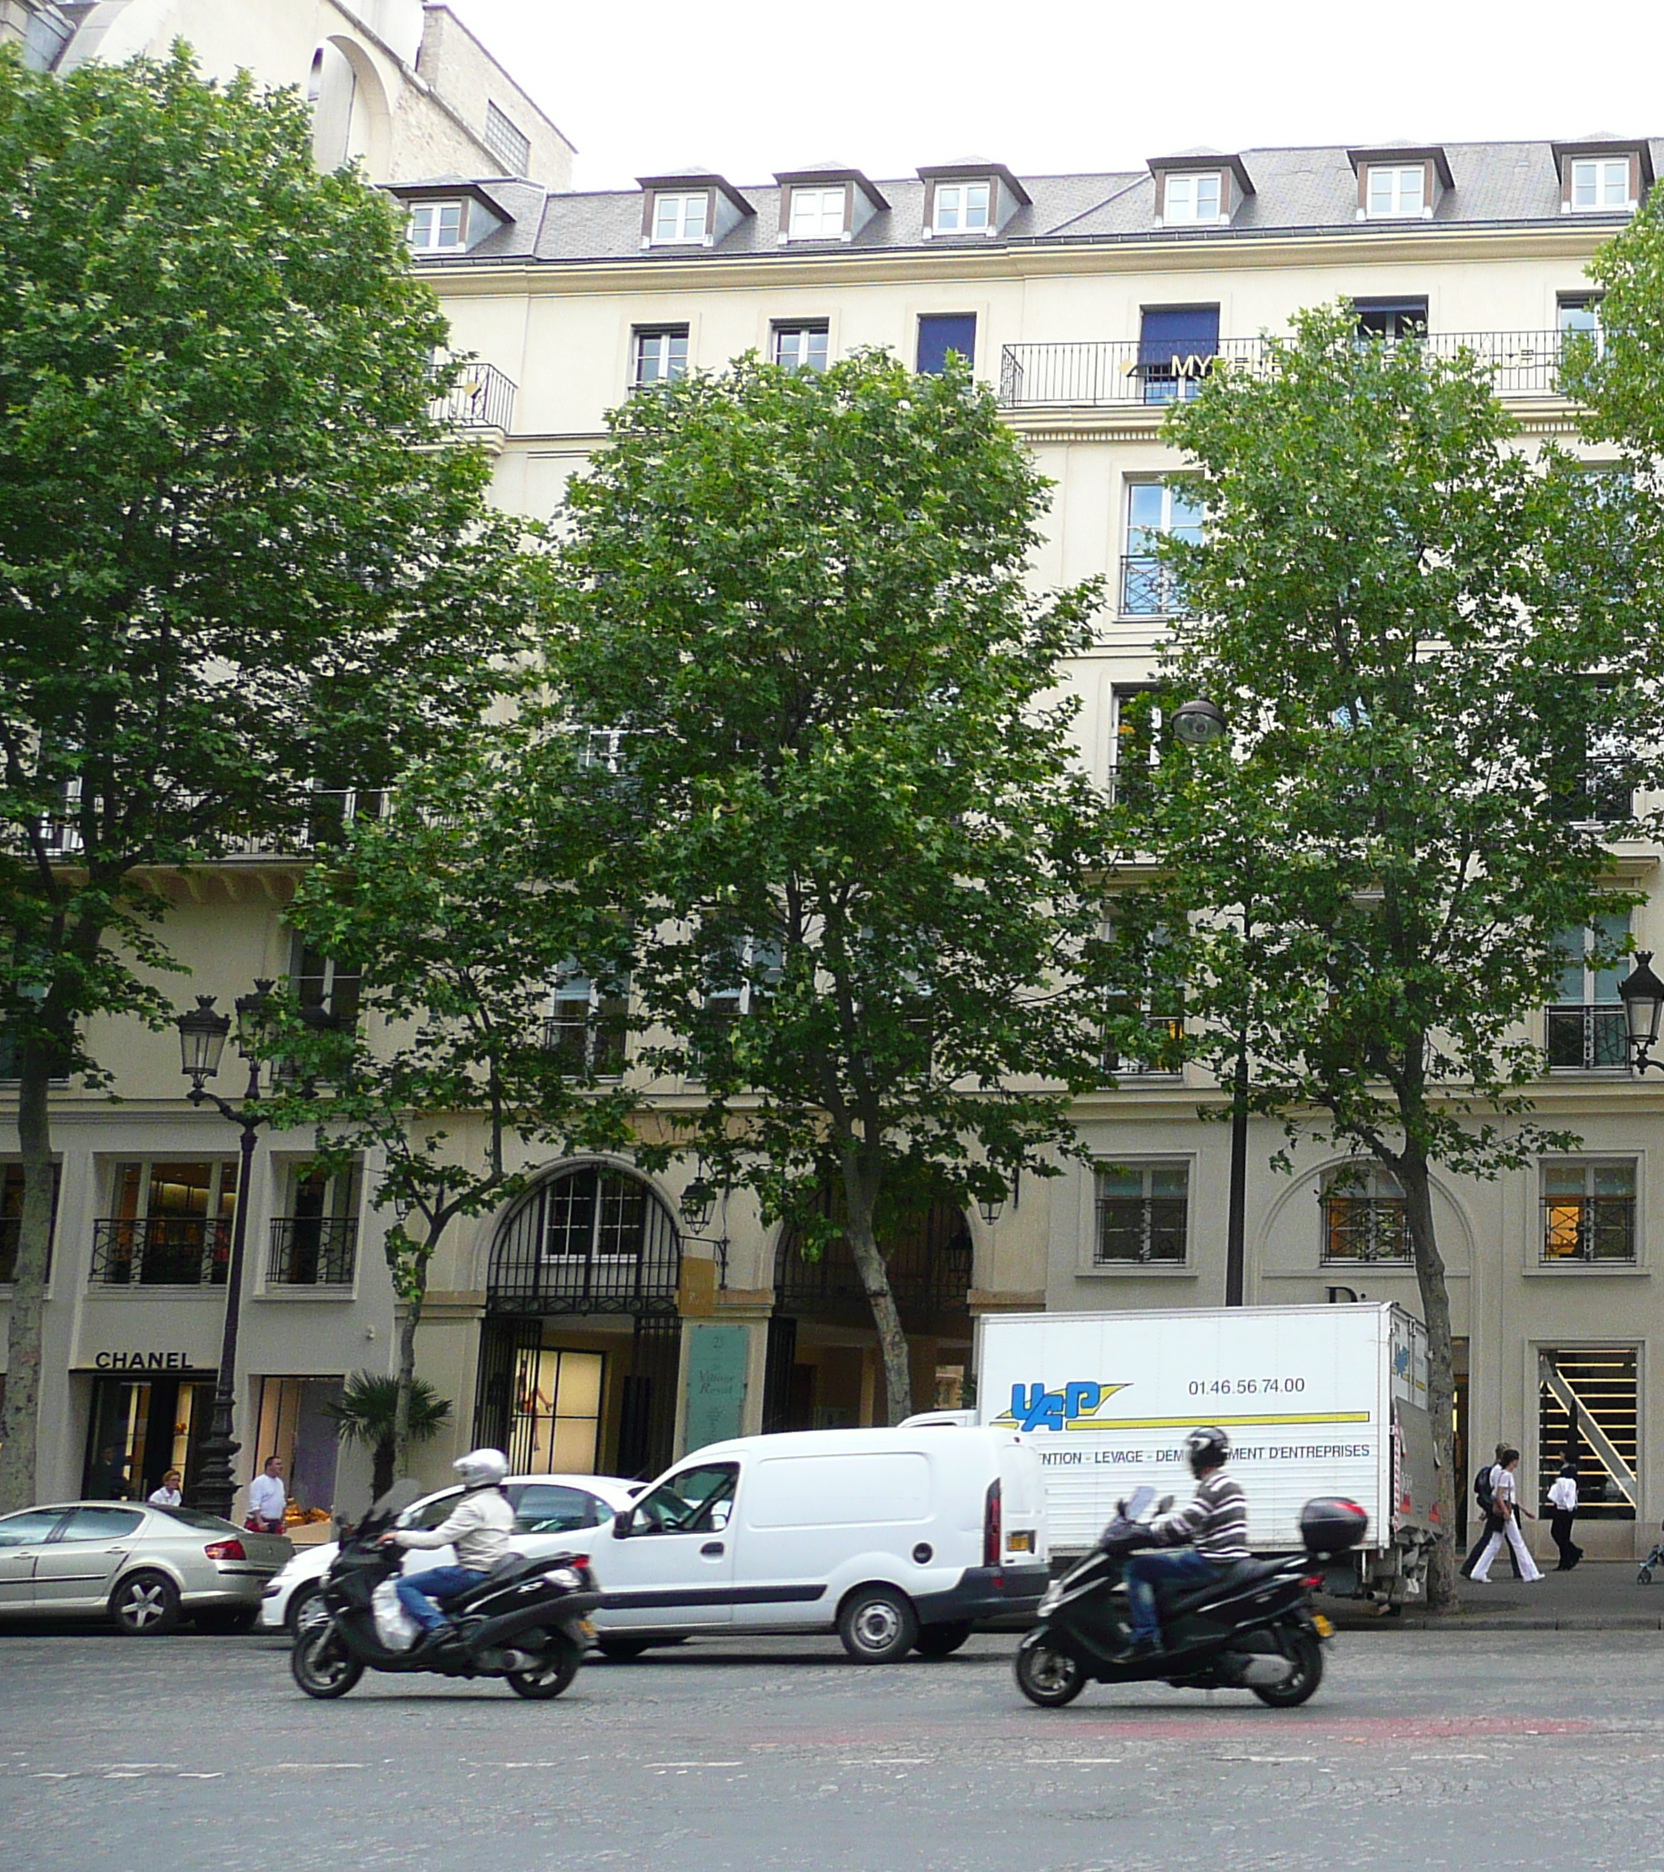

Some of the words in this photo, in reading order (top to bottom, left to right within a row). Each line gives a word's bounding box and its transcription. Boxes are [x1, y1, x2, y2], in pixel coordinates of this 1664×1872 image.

[95, 1352, 194, 1369] CHANEL
[1187, 1378, 1306, 1396] 01.46.56.74.00
[1040, 1452, 1082, 1465] NTION
[1094, 1450, 1144, 1464] LEVAGE
[1269, 1444, 1370, 1459] D'ENTREPRISES
